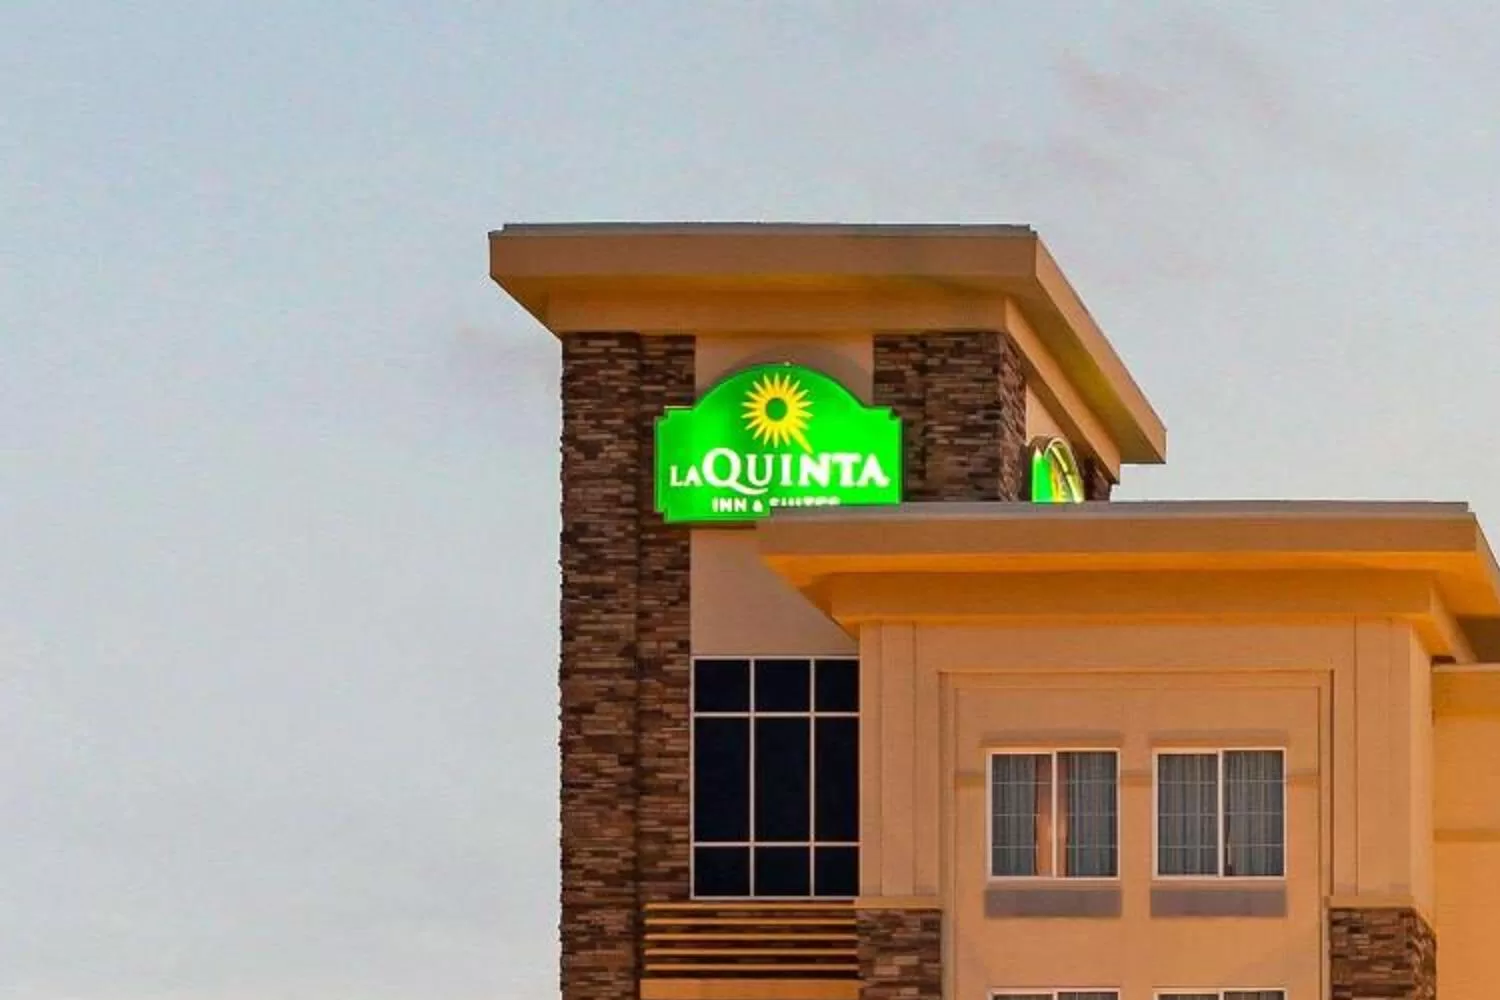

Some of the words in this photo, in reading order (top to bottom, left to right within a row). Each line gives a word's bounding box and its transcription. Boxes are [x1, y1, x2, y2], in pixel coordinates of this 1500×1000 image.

[669, 465, 703, 487] LA
[702, 447, 891, 495] QUINTA
[711, 497, 747, 513] INN
[752, 499, 764, 513] &
